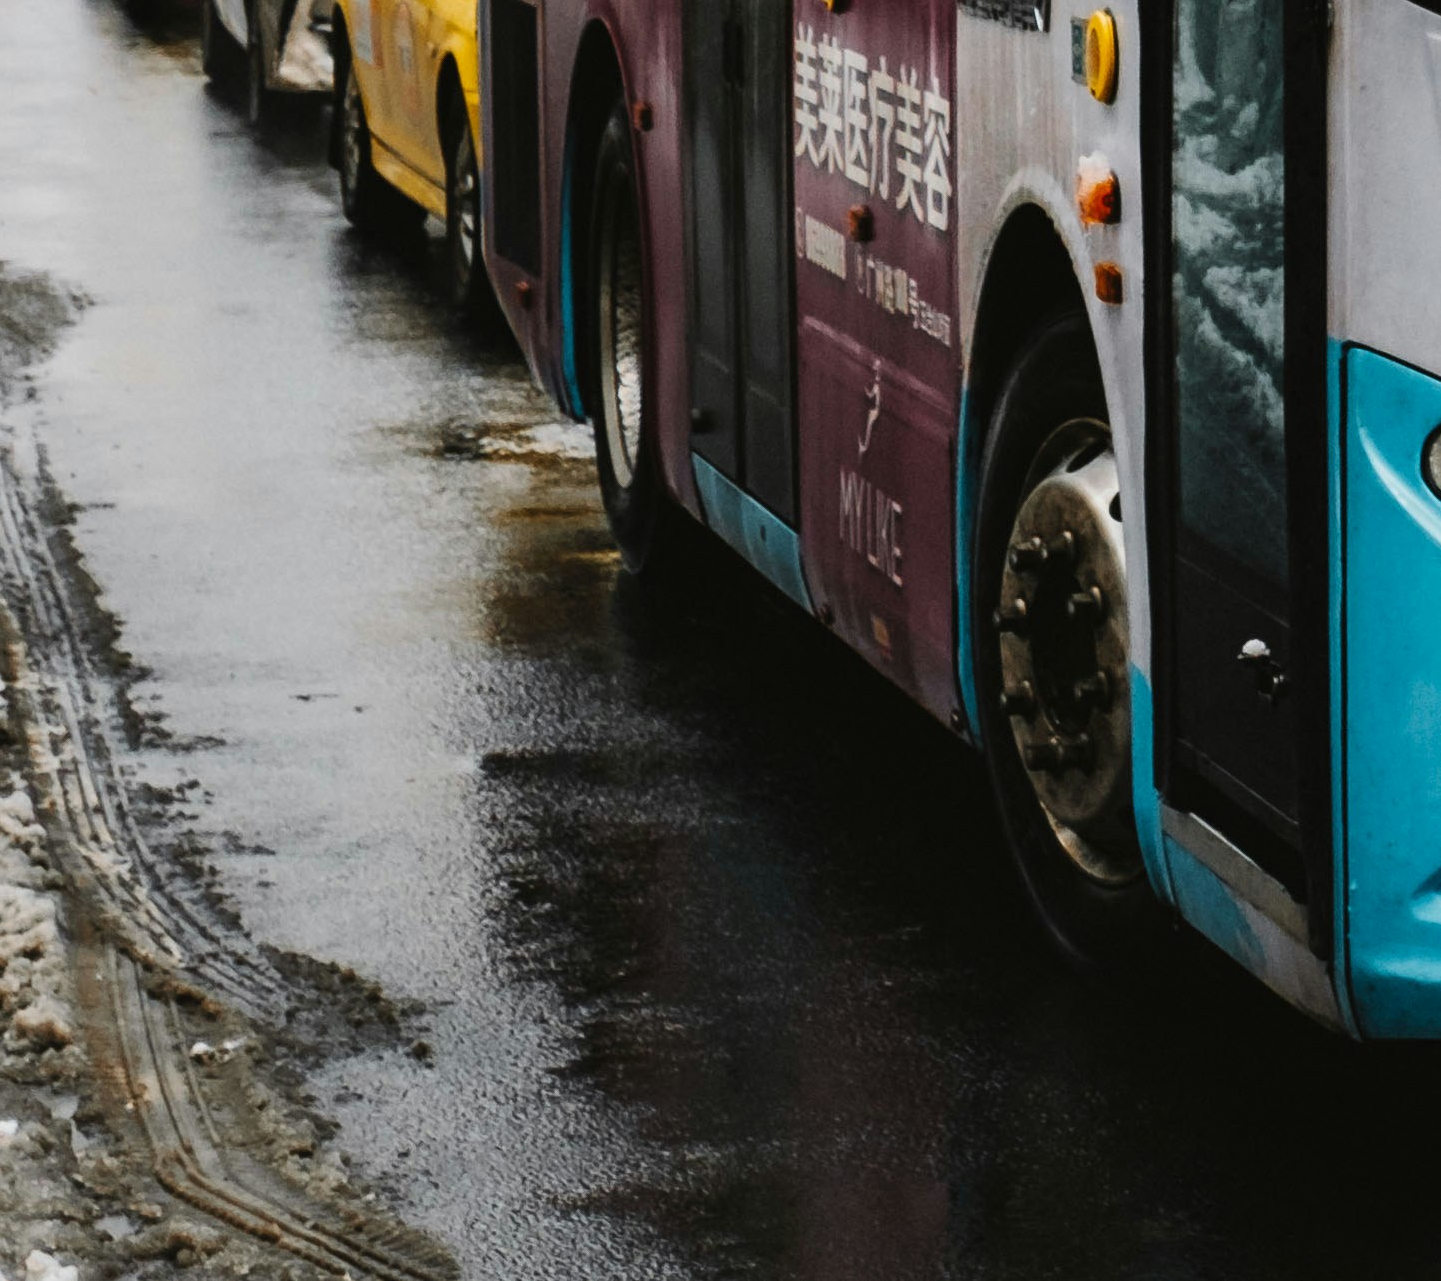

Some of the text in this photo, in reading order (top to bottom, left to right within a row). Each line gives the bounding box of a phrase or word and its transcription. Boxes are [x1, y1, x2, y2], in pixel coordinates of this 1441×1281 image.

[794, 22, 952, 231] 美莱医疗美容
